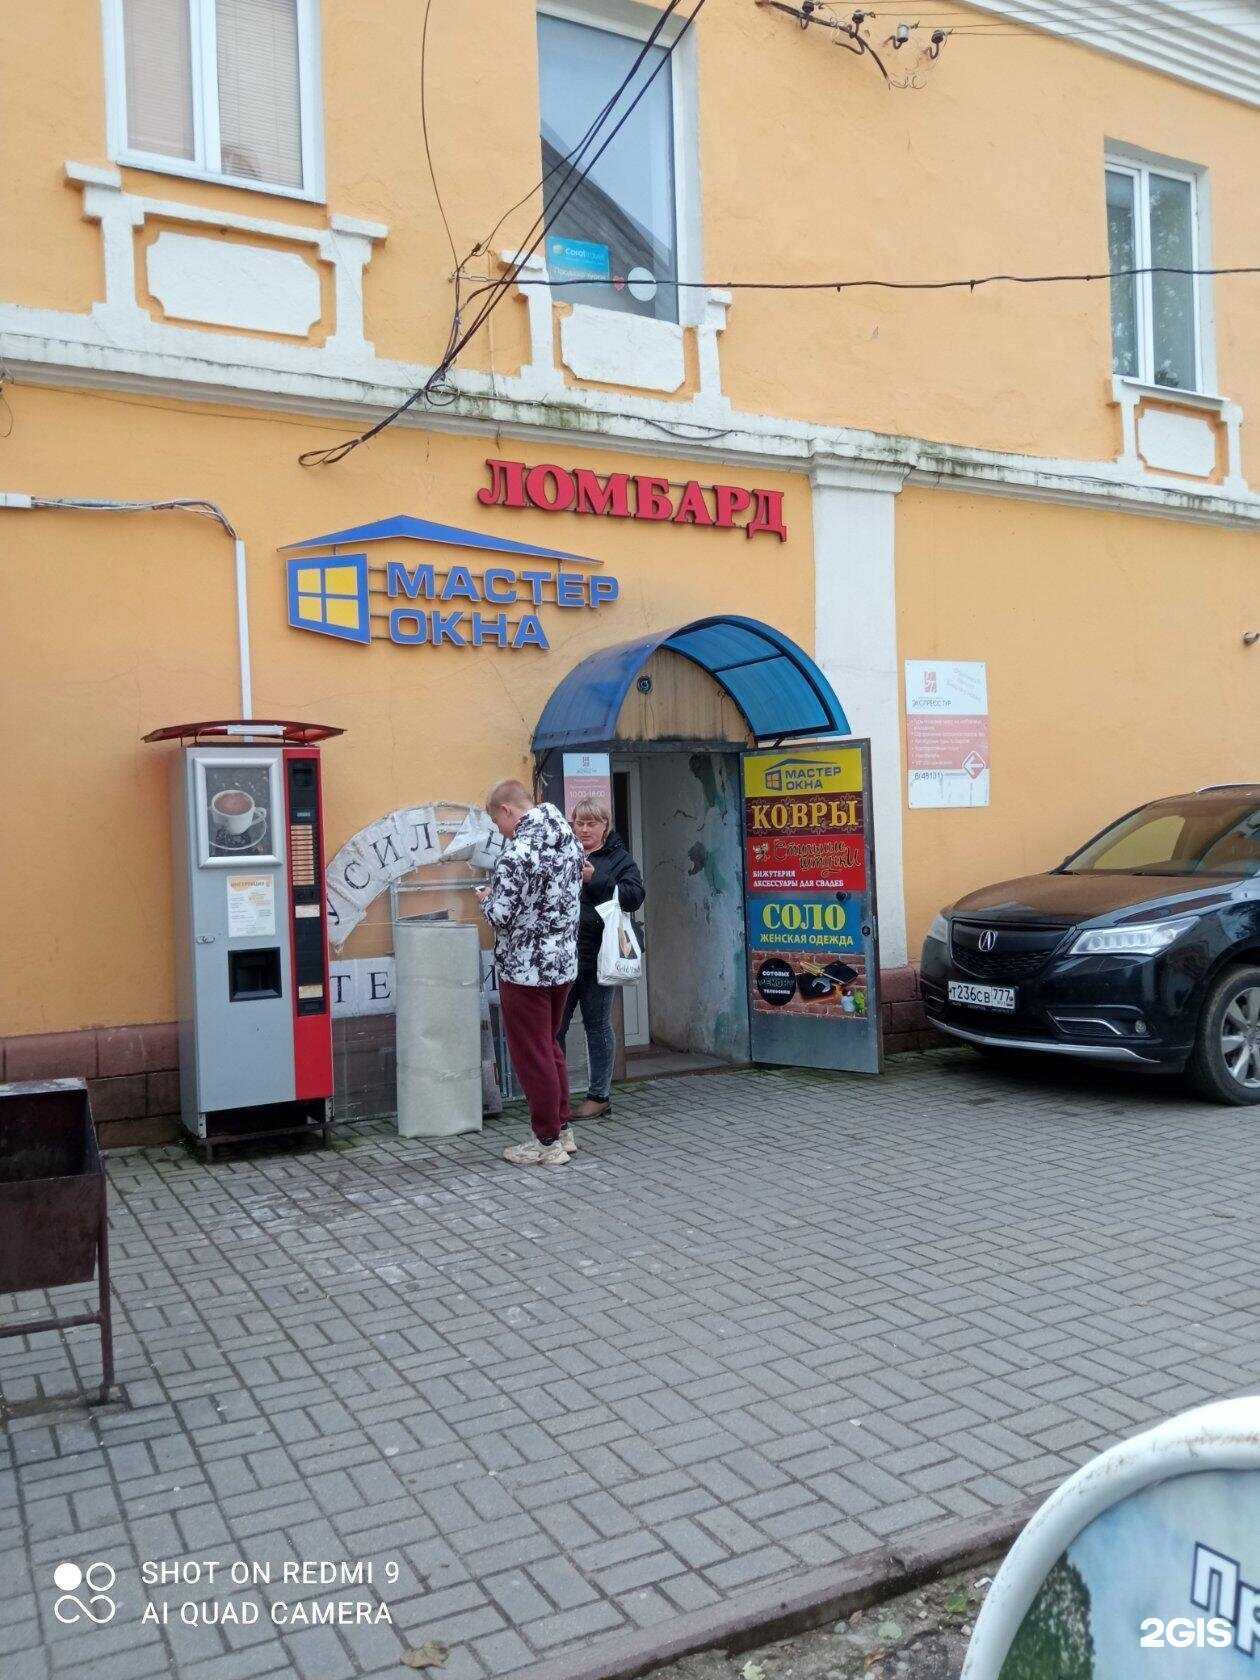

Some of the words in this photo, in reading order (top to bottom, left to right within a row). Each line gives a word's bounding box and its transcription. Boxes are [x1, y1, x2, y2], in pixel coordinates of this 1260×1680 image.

[478, 458, 787, 543] ЛОМБАРД
[387, 561, 620, 608] МАСТЕР
[389, 607, 551, 650] ОКНА
[785, 766, 842, 779] МАСТЕР
[786, 780, 823, 791] ОКНА
[751, 800, 859, 829] КОВРЫ
[753, 870, 796, 878] БИЖУТЕРИЯ
[762, 903, 846, 931] СОЛО
[760, 933, 807, 945] ЖЕНСКАЯ
[809, 934, 854, 948] ОДЕЖДА
